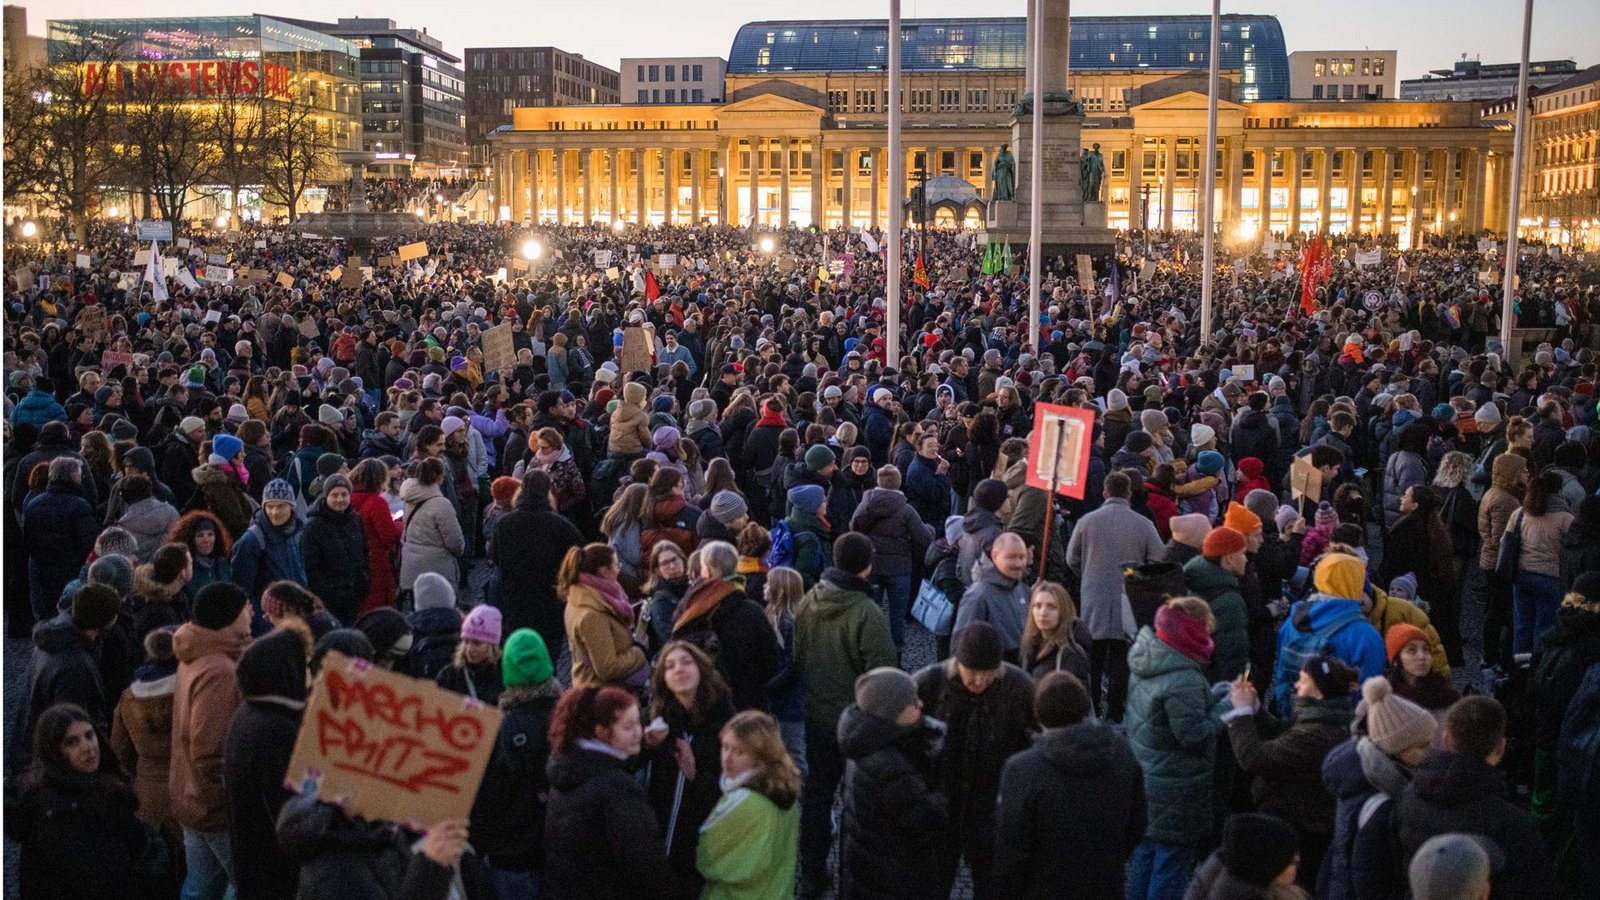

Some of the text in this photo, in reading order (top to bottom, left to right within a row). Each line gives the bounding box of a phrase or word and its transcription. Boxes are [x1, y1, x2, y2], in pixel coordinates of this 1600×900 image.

[135, 61, 259, 97] SYSTEMS
[263, 62, 291, 98] FAIL
[317, 708, 470, 793] FRITZ
